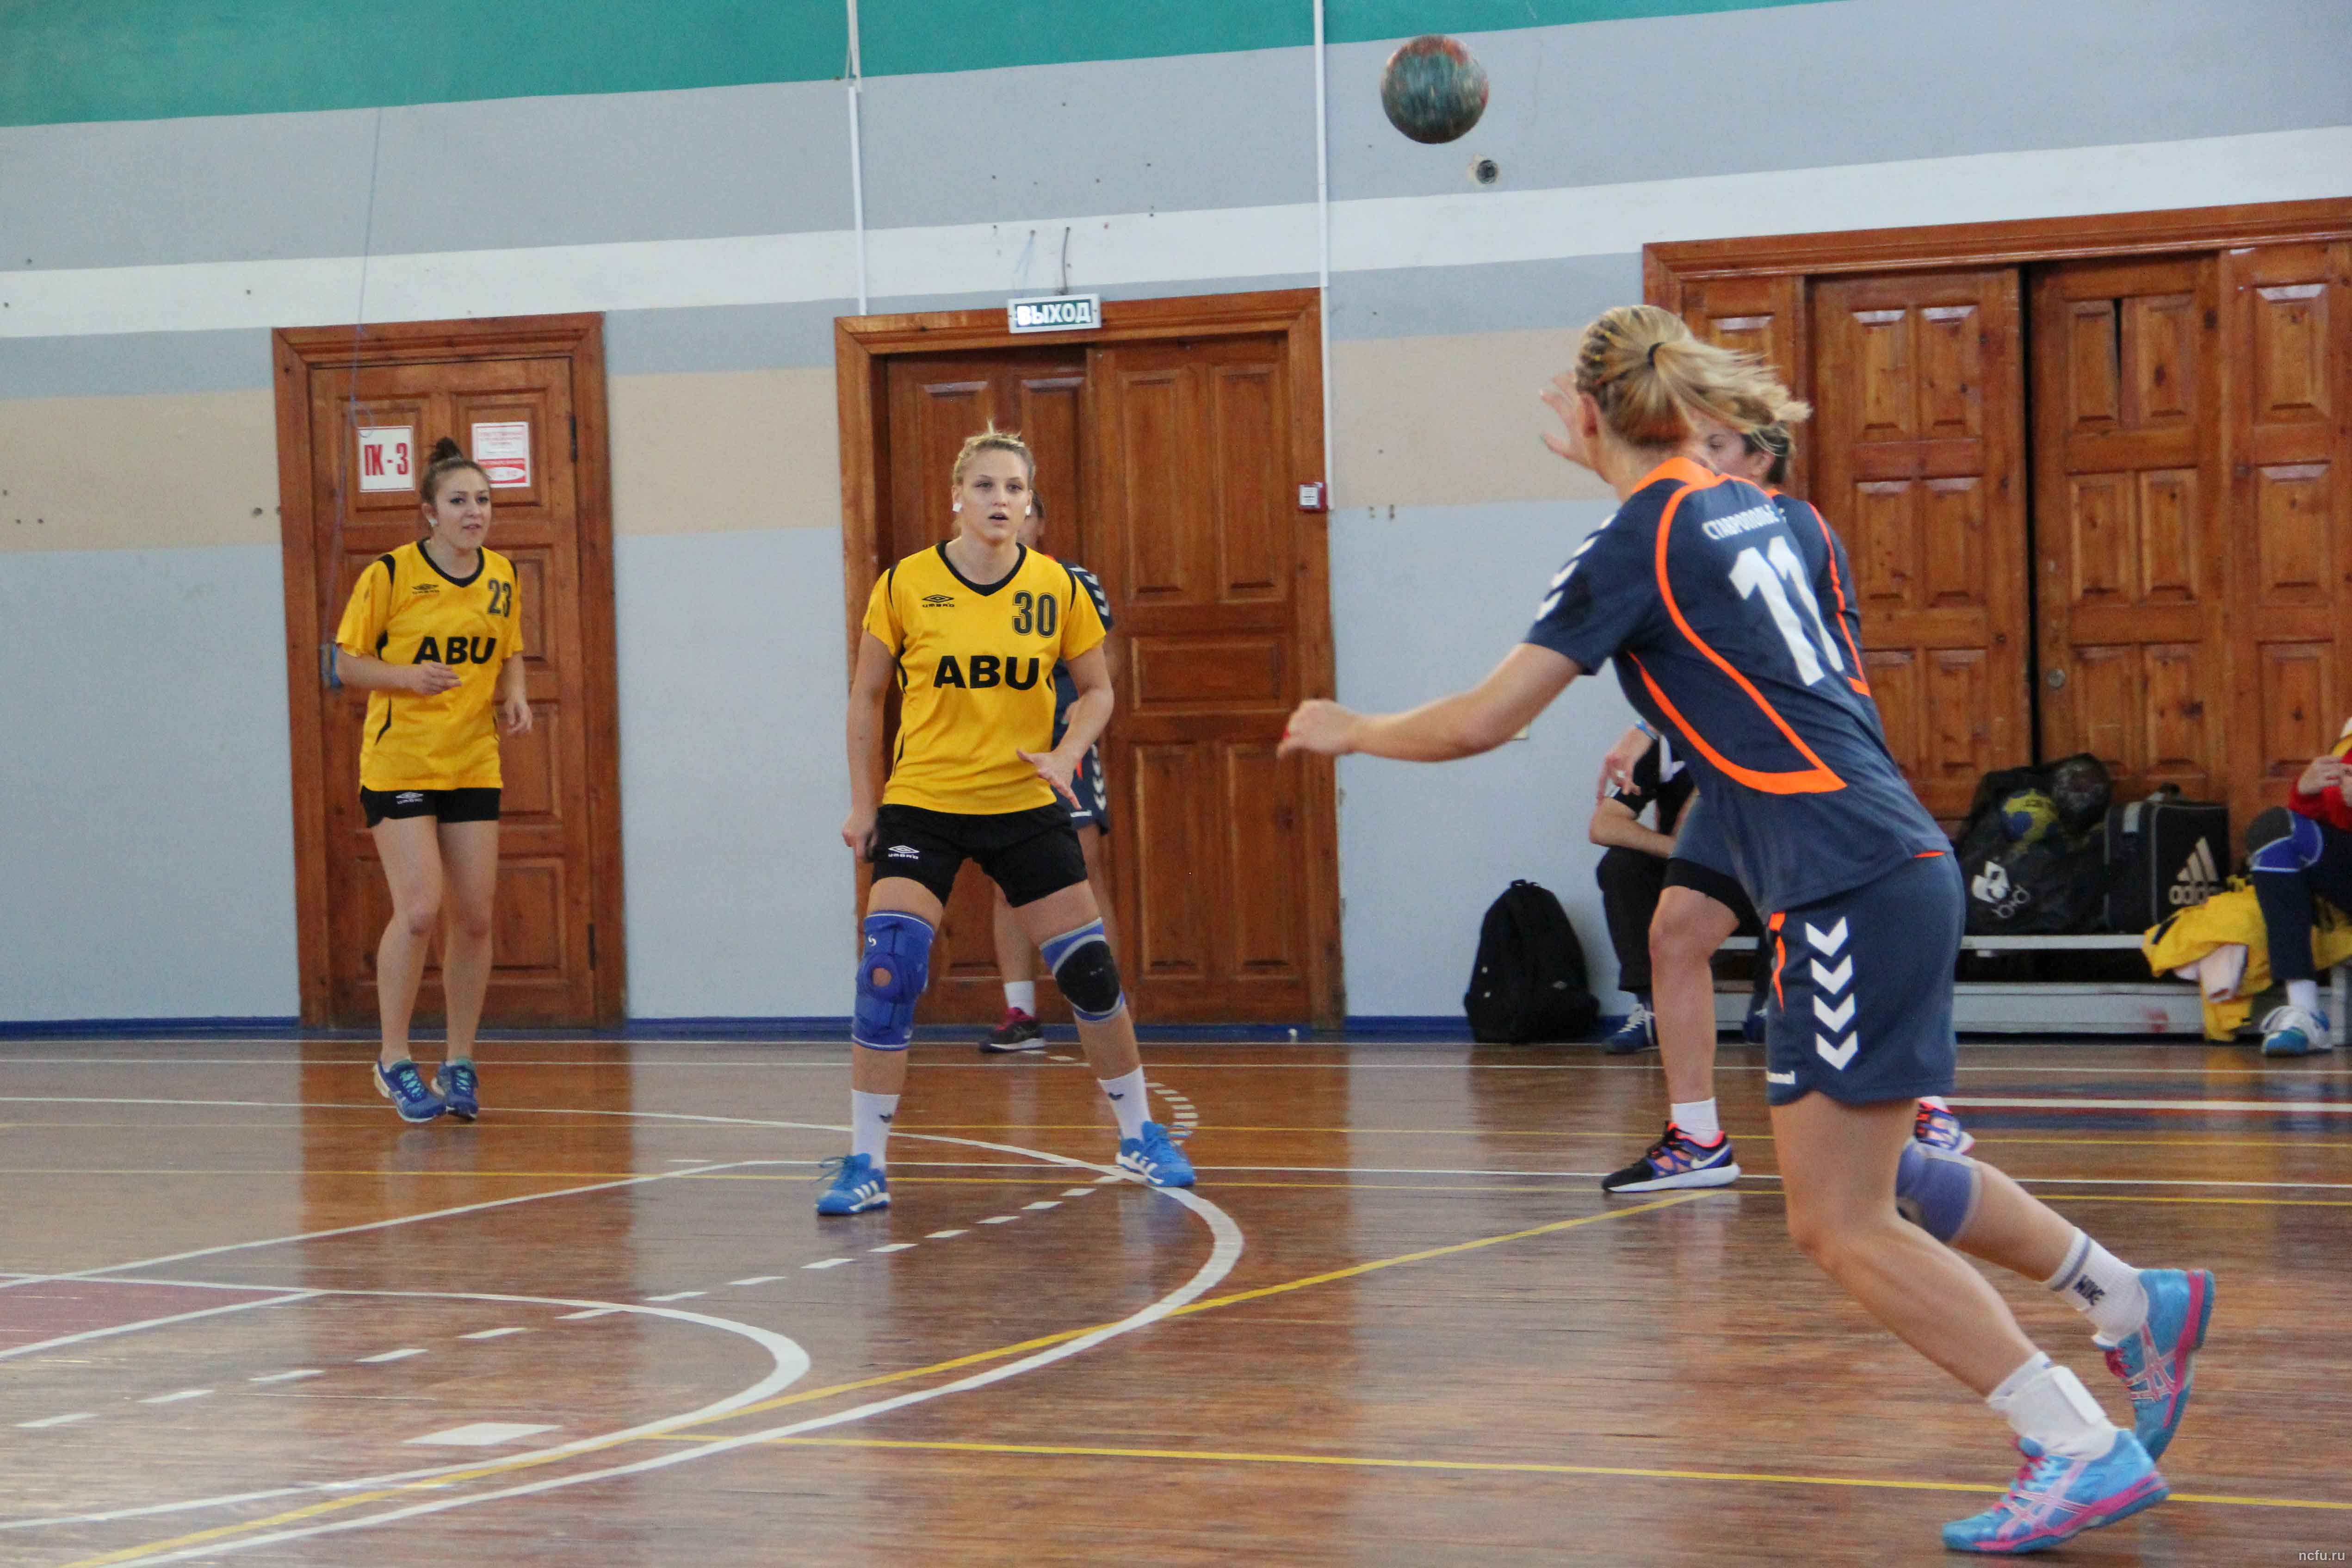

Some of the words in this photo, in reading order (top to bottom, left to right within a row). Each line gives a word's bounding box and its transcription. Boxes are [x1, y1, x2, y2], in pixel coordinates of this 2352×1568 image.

[1017, 303, 1092, 325] ВЫХОД
[488, 578, 512, 618] 23
[1012, 590, 1058, 638] 30
[1729, 535, 1844, 687] 11
[412, 636, 497, 665] ABU
[933, 655, 1040, 690] ABU
